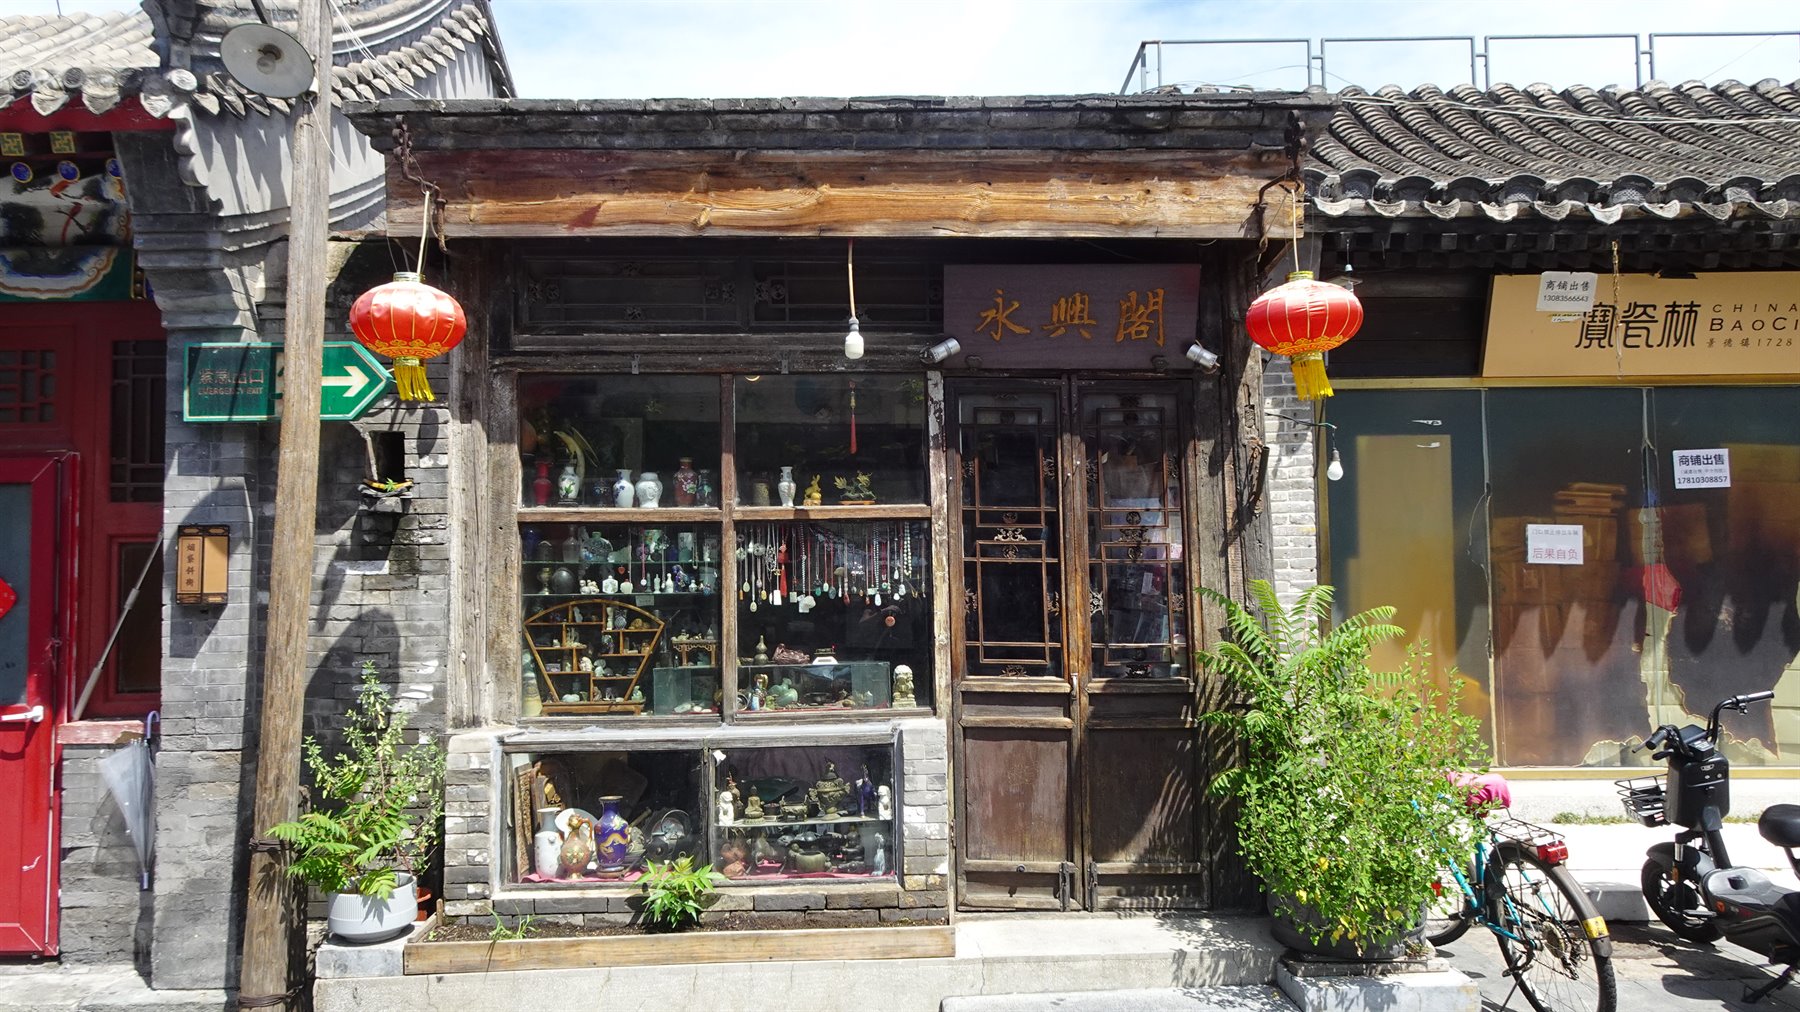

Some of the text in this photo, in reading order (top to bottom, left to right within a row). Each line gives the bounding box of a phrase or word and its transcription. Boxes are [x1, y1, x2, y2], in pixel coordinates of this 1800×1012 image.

[1545, 280, 1589, 291] 商铺出售
[1712, 303, 1798, 313] CHINA
[975, 289, 1165, 347] 永興閣
[246, 387, 264, 395] EXIT
[1678, 454, 1725, 466] 商铺出售
[1533, 547, 1578, 560] 后果自负
